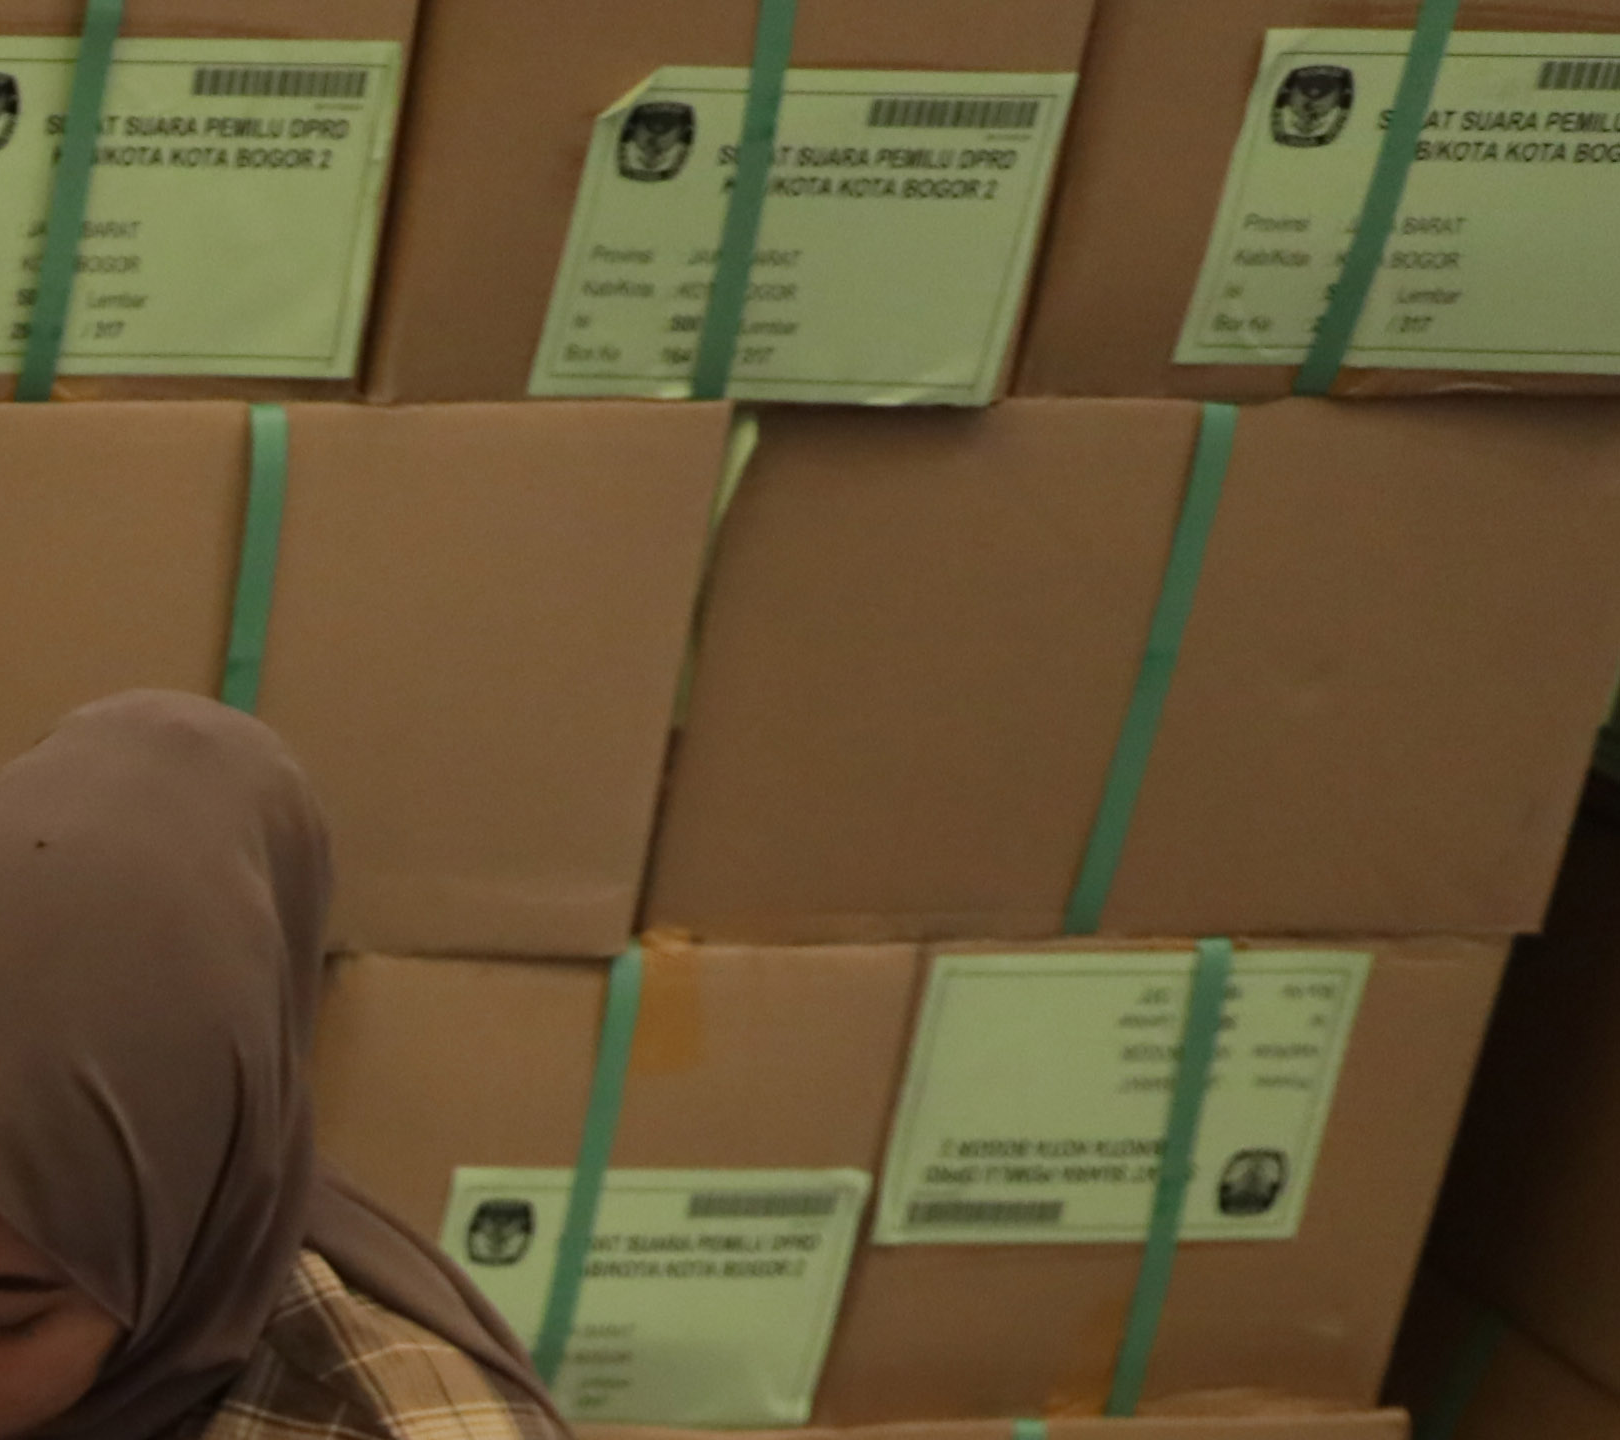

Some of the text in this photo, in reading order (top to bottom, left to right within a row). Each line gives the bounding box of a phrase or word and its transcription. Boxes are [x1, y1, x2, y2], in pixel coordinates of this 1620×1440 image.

[126, 116, 197, 136] SUARA
[1462, 112, 1537, 131] SUARA
[170, 149, 229, 168] KOTA
